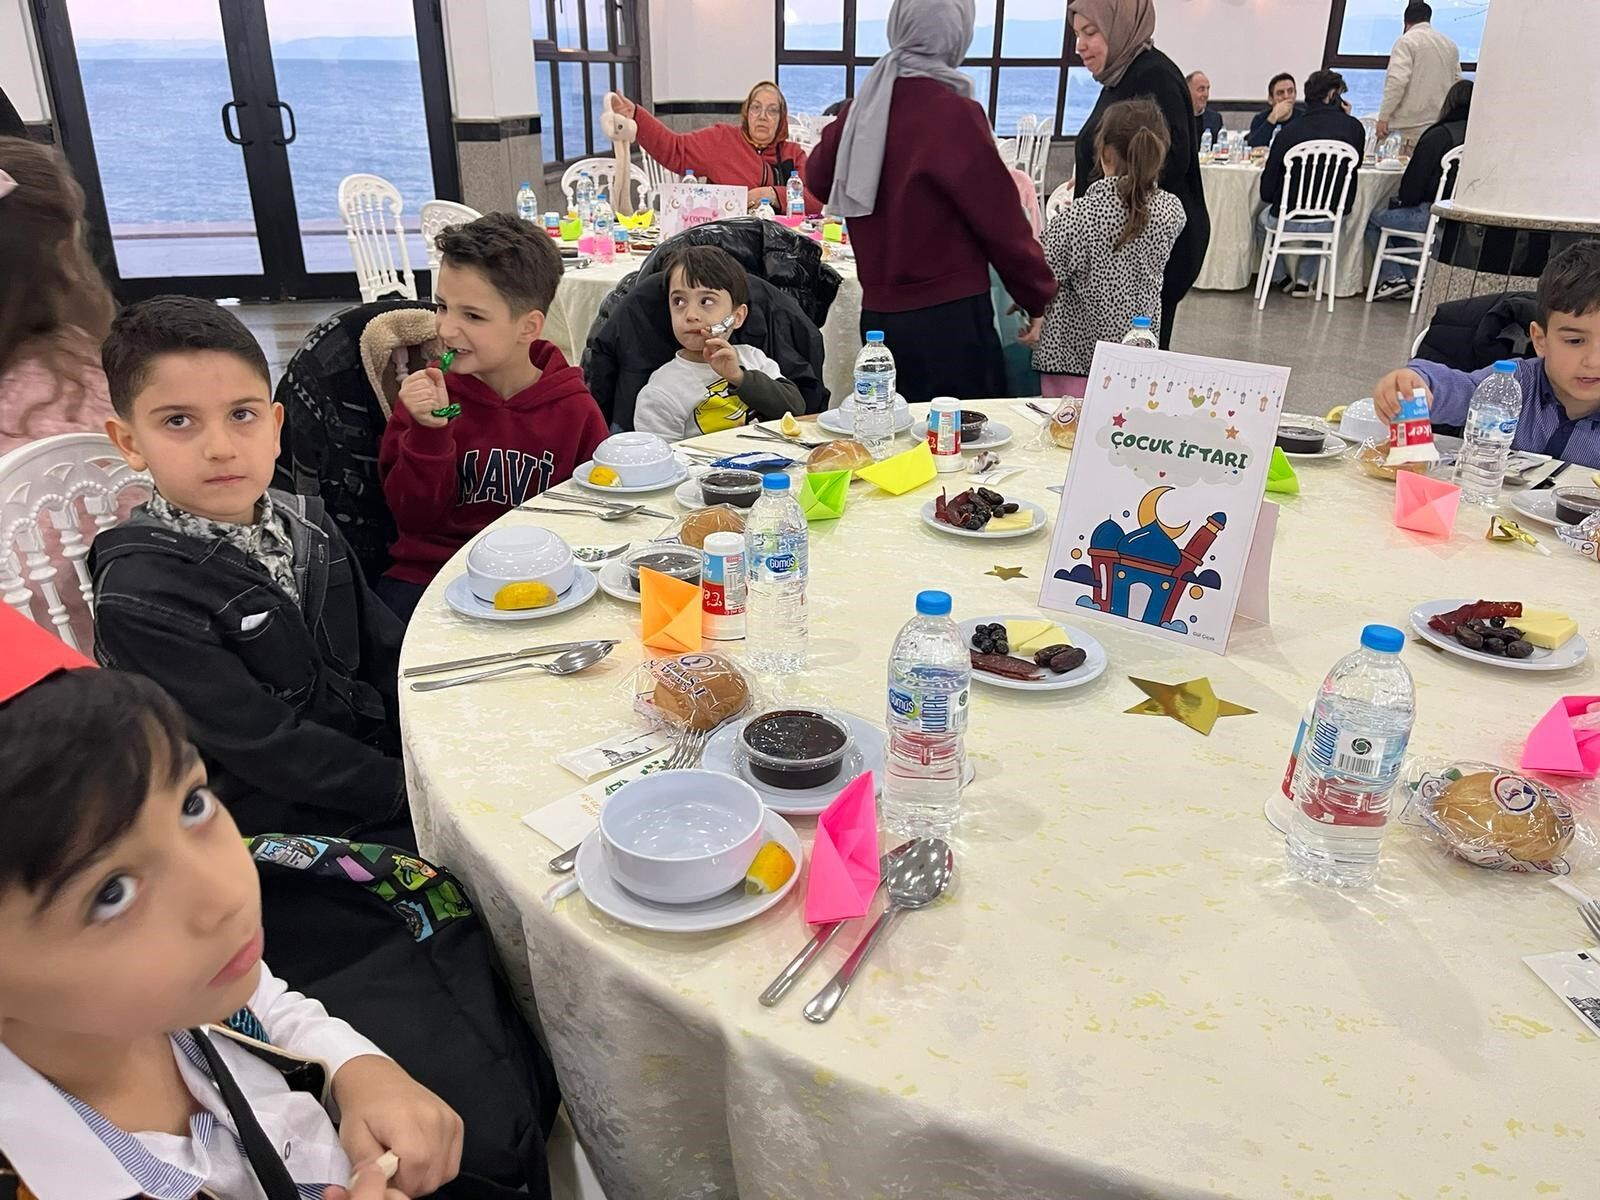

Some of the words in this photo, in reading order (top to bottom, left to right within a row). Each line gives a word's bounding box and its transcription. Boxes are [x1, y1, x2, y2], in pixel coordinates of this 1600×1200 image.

[1407, 423, 1432, 437] ker
[1110, 430, 1174, 455] ÇOCUK
[1177, 439, 1249, 470] İFTARI
